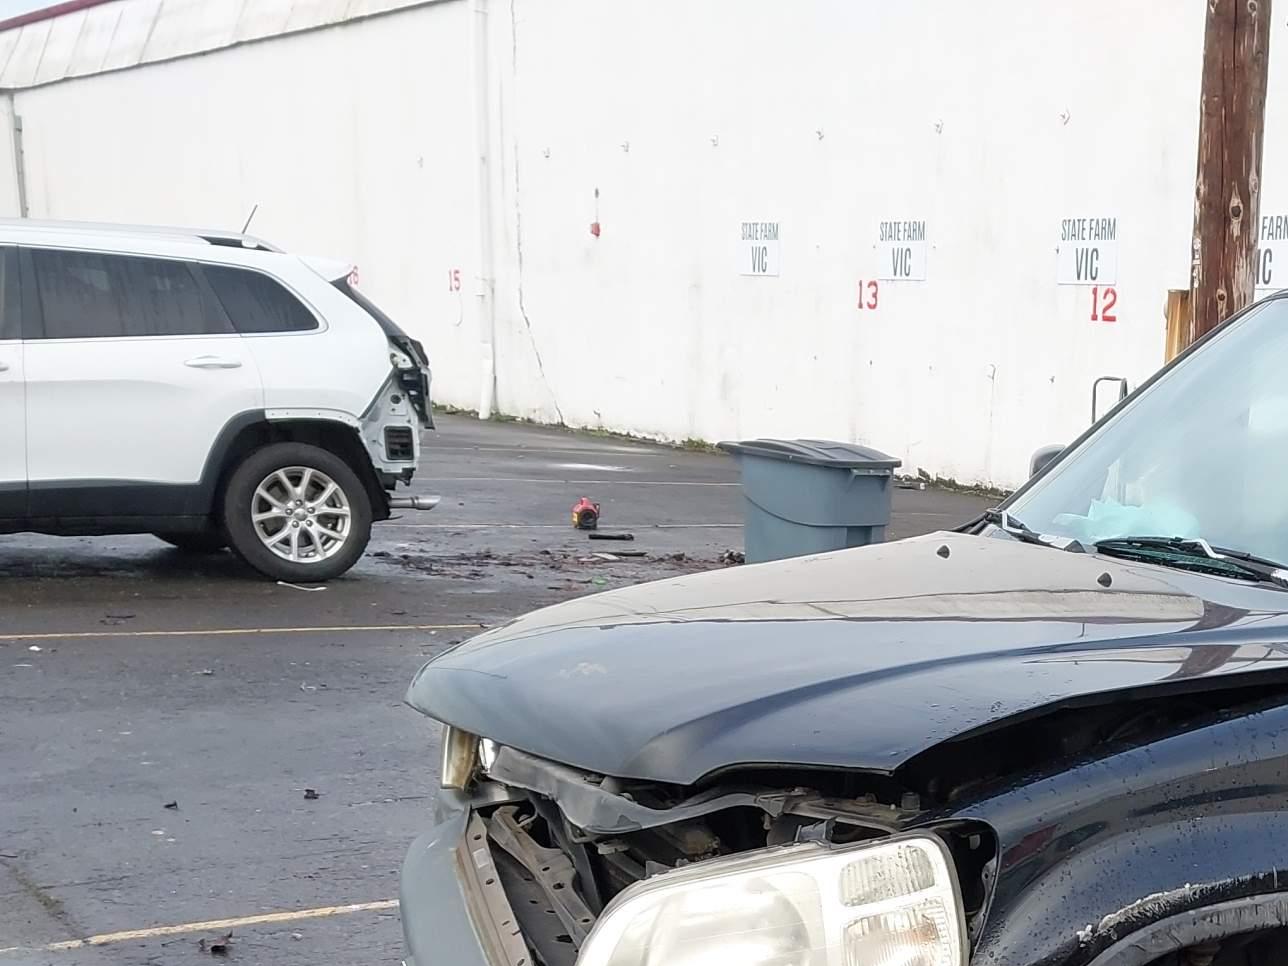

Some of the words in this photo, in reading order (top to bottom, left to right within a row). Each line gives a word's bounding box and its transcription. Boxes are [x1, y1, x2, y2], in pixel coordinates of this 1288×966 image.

[741, 222, 758, 241] STATE
[759, 222, 779, 241] FARM
[880, 221, 901, 241] STATE
[903, 221, 926, 241] FARM
[1061, 219, 1086, 241] STATE
[1088, 218, 1116, 241] FARM
[751, 246, 767, 273] VIC
[892, 248, 912, 277] VIC
[1075, 247, 1099, 281] VIC
[1255, 248, 1272, 285] IC
[448, 269, 461, 292] 15
[857, 279, 879, 310] 13
[1090, 287, 1117, 322] 12
